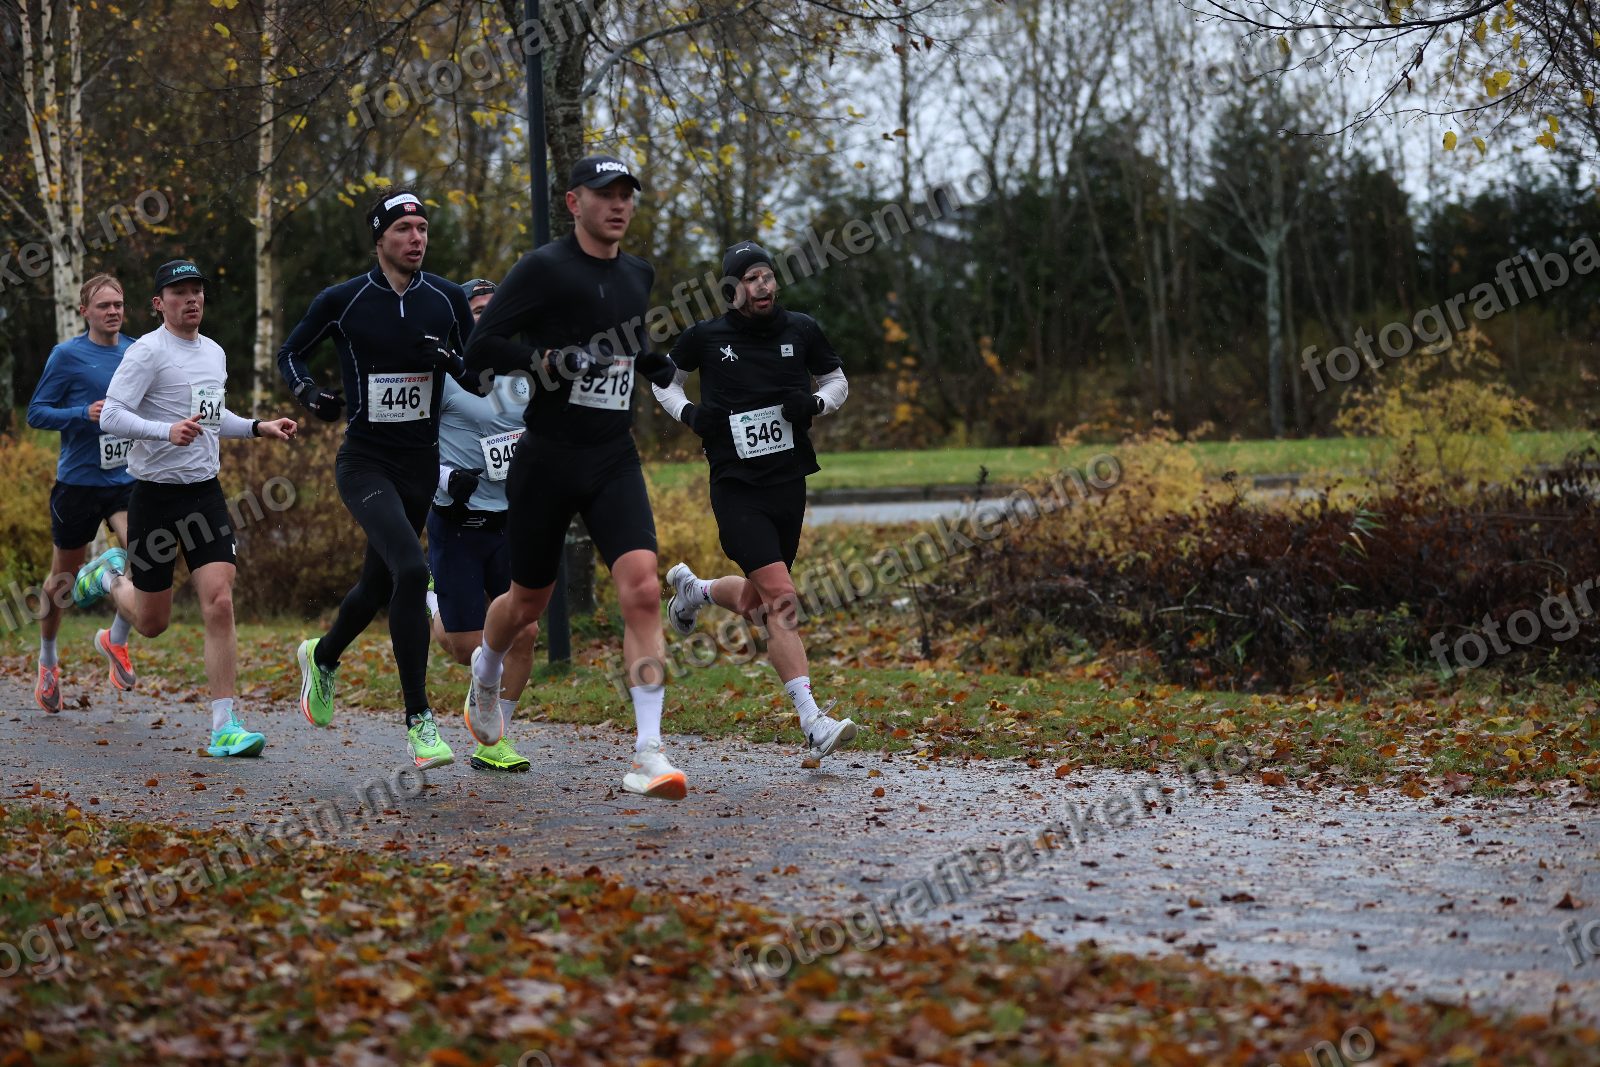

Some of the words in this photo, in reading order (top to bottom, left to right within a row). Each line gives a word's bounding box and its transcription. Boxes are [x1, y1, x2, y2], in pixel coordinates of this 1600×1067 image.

[596, 162, 629, 175] HOKA
[173, 265, 199, 276] HOKA
[374, 376, 429, 384] NORGESTESTEN
[581, 371, 630, 396] 9218
[381, 386, 420, 410] 446
[200, 400, 221, 420] 614
[745, 420, 783, 447] 546
